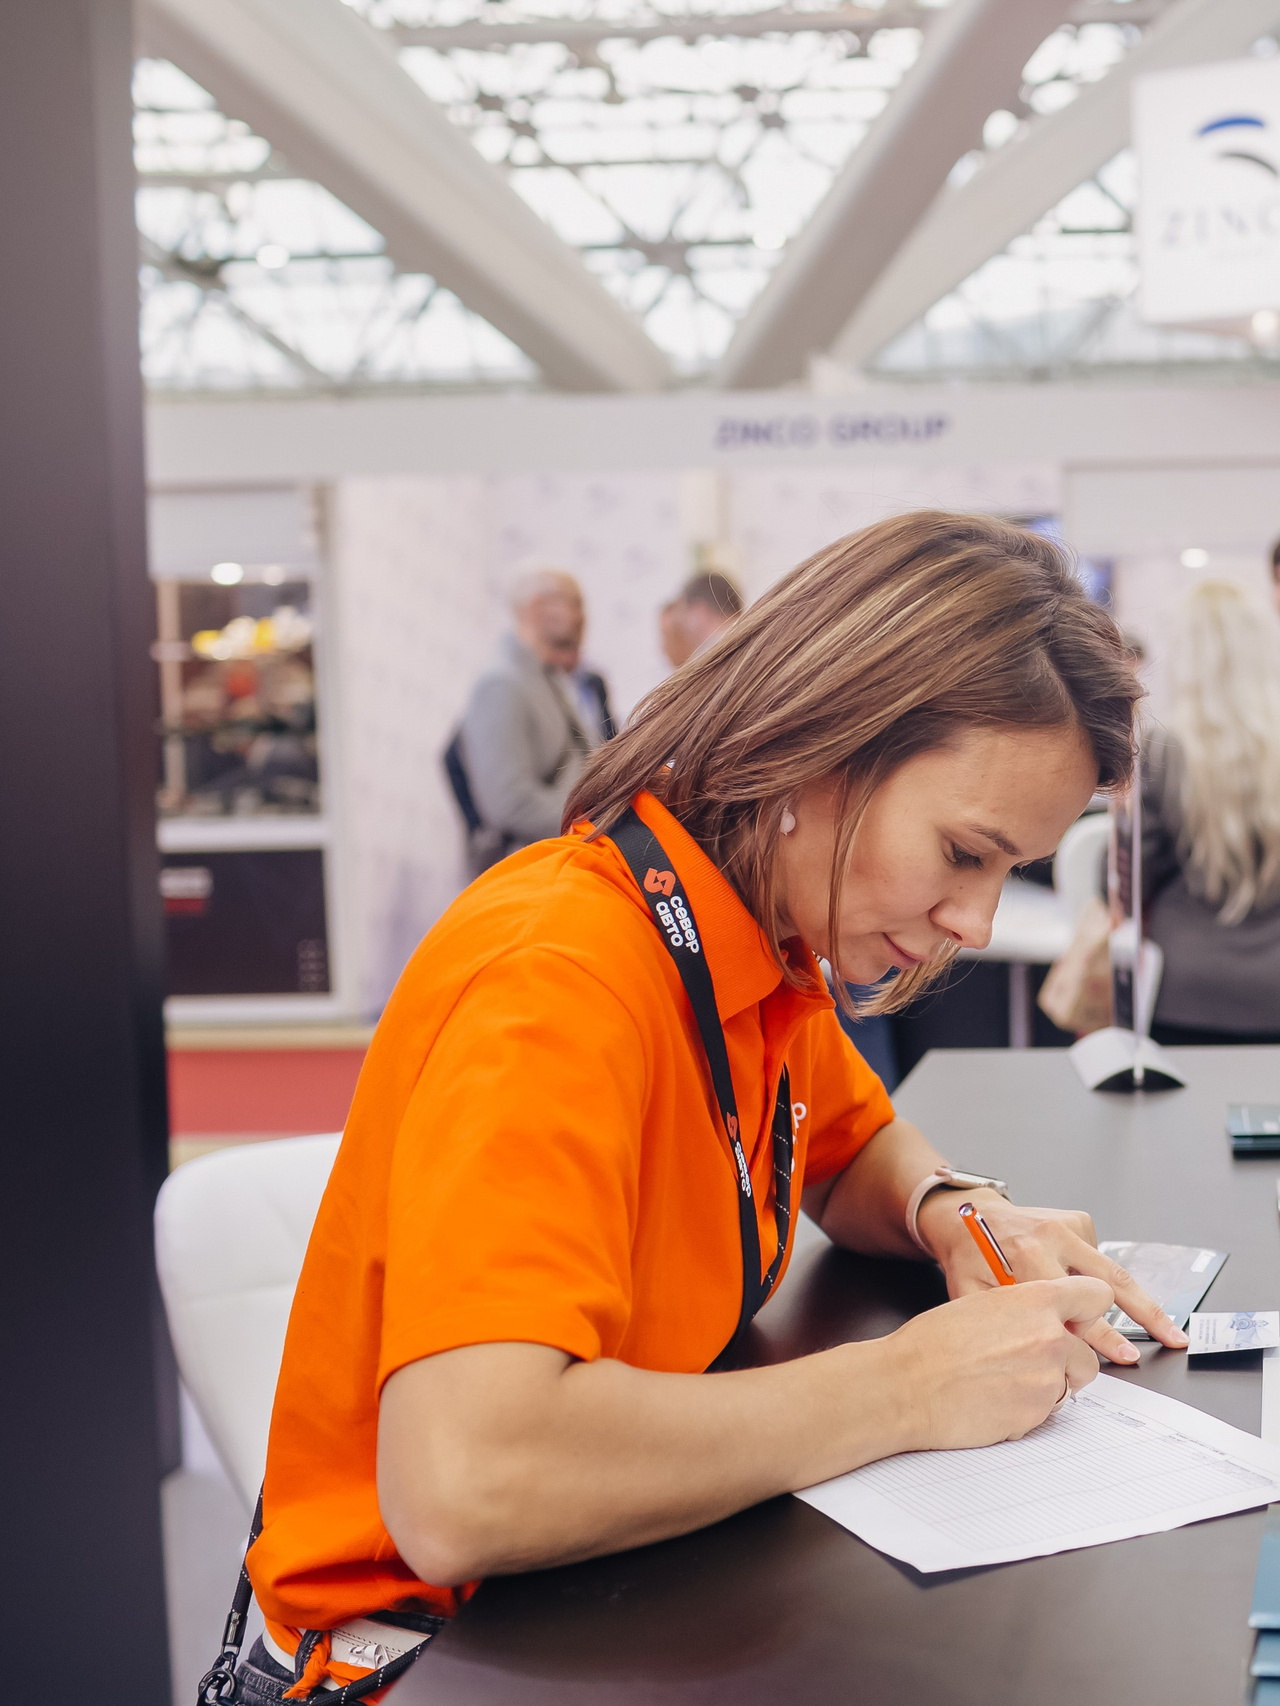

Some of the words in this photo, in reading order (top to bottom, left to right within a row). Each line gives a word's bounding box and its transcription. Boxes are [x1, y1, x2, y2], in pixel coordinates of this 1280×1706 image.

[714, 414, 817, 451] ZINCO
[830, 410, 950, 445] GROUP
[655, 901, 684, 948] авто
[670, 896, 700, 955] север
